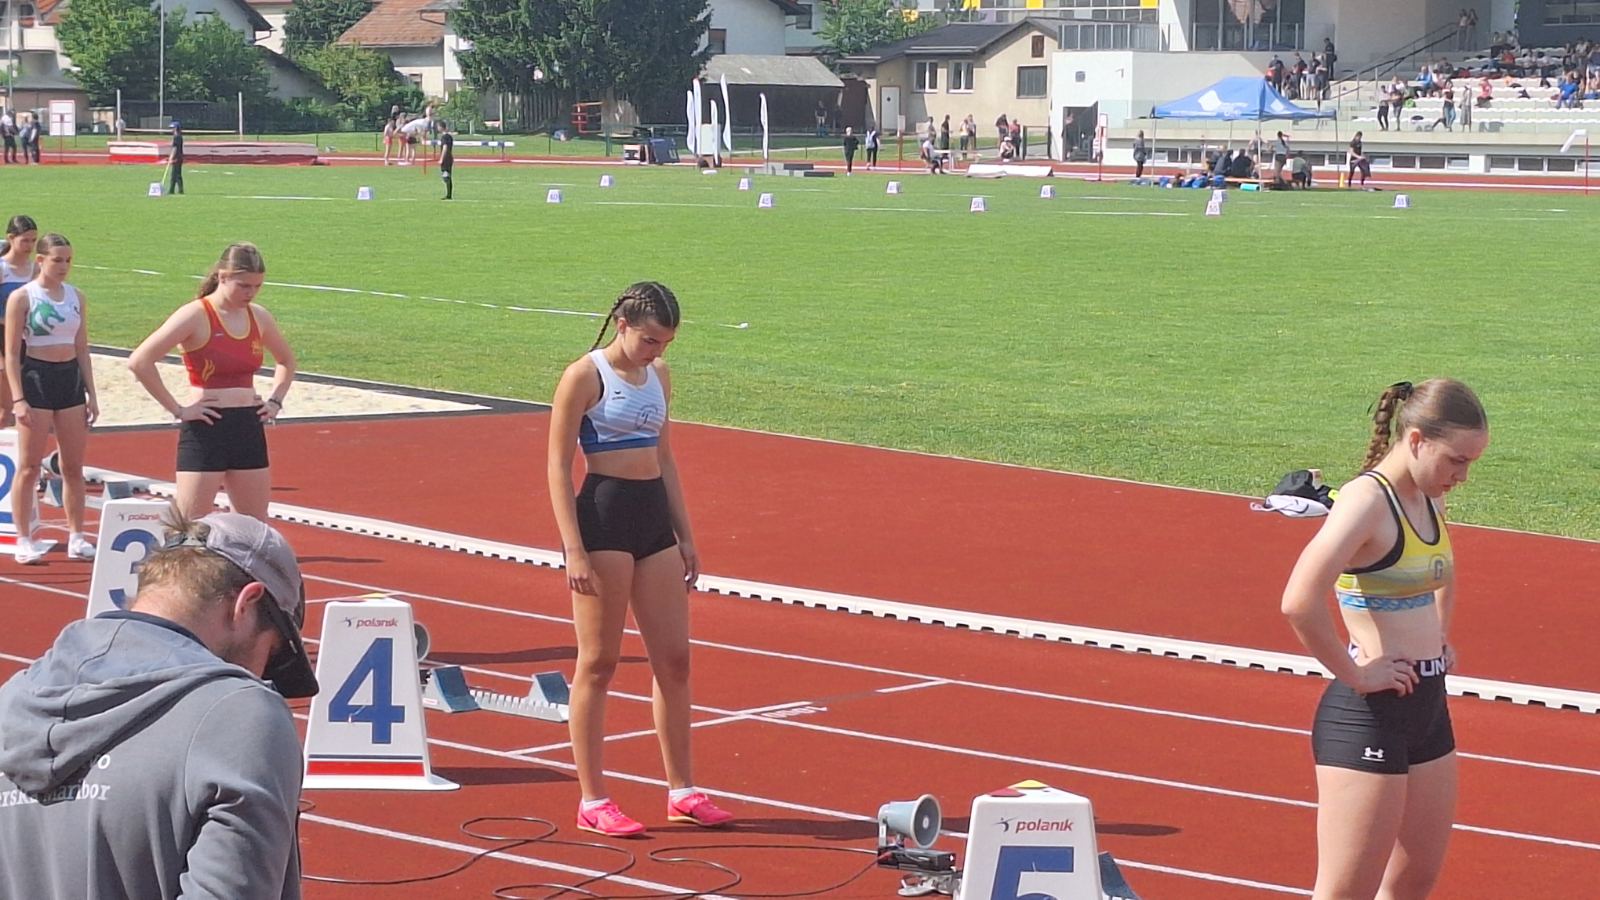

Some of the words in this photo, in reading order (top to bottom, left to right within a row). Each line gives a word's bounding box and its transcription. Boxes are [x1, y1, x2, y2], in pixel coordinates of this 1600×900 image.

[356, 617, 398, 629] polanik
[328, 637, 405, 744] 4
[1015, 819, 1074, 834] polanik
